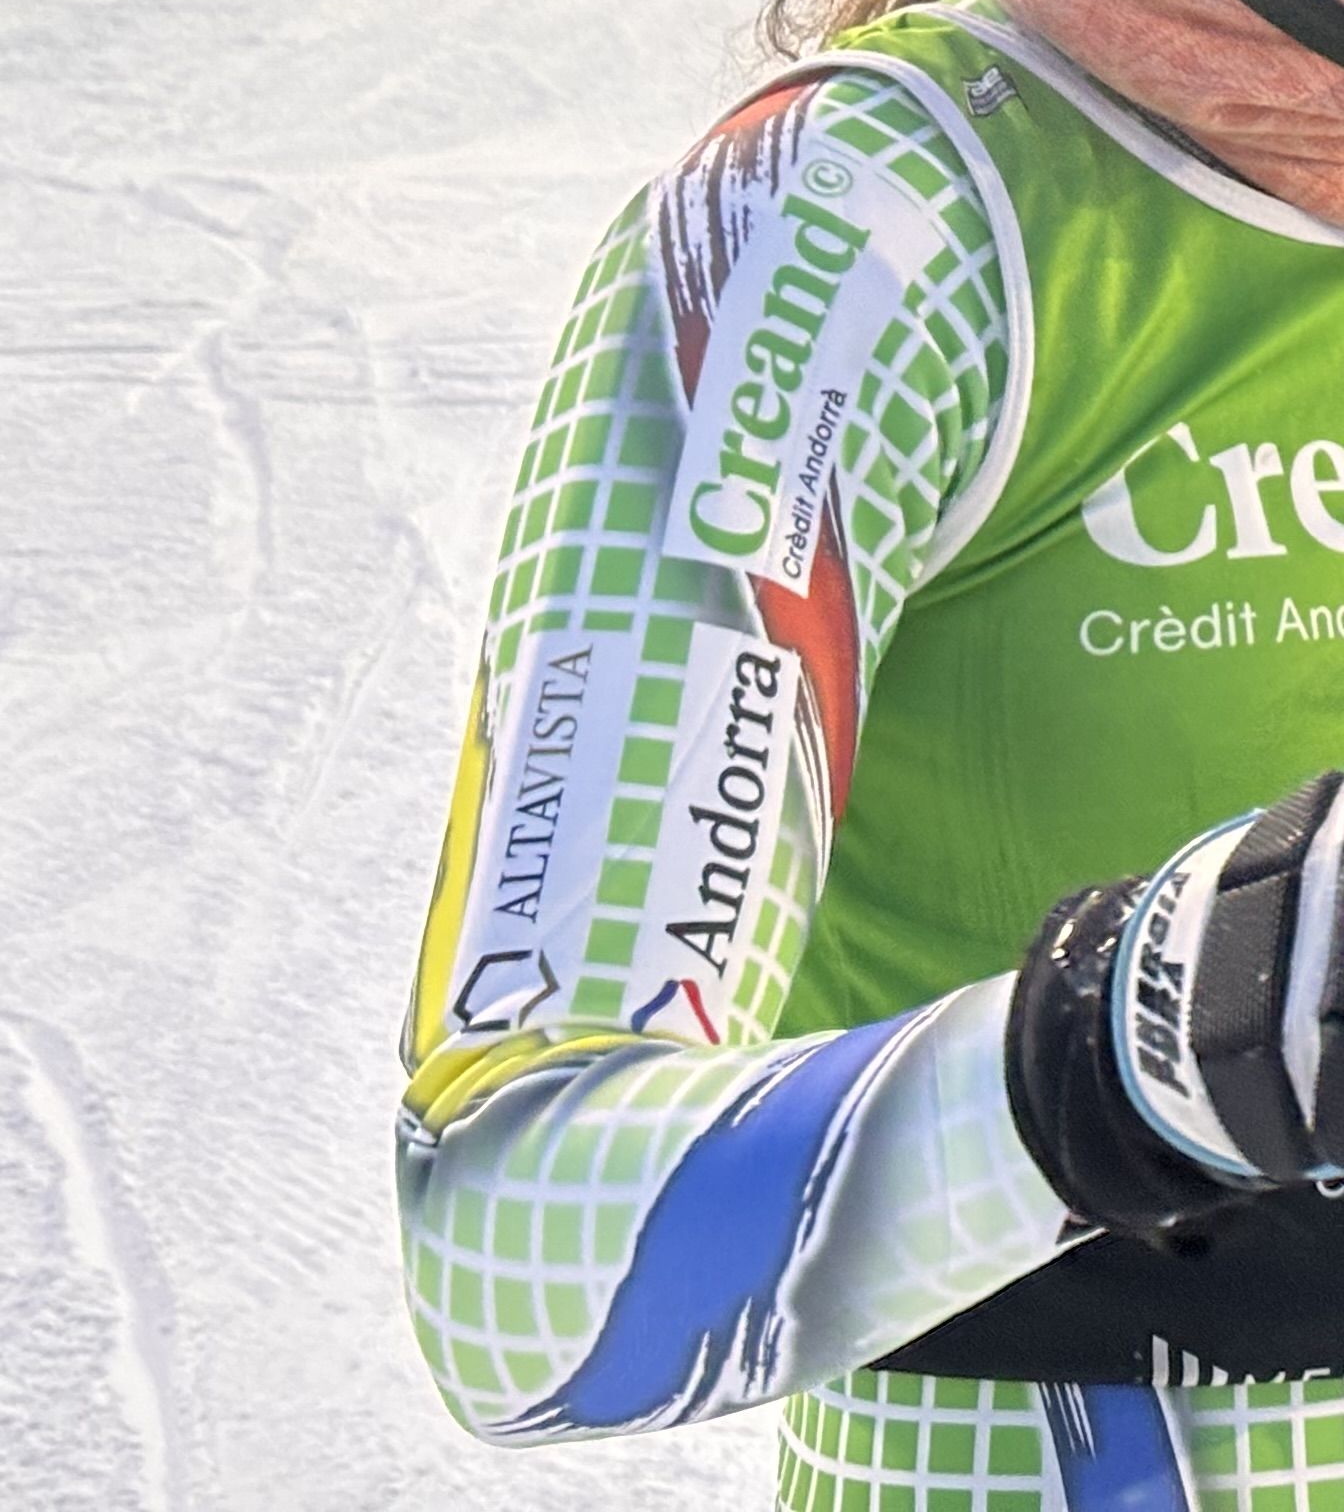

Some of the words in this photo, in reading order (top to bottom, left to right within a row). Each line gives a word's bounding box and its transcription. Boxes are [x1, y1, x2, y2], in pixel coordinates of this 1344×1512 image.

[782, 496, 815, 579] Crèdit
[799, 388, 848, 495] Andorrà
[1079, 600, 1257, 657] Crèdit
[493, 642, 593, 924] ALTAVISTA
[664, 648, 782, 978] Andorra
